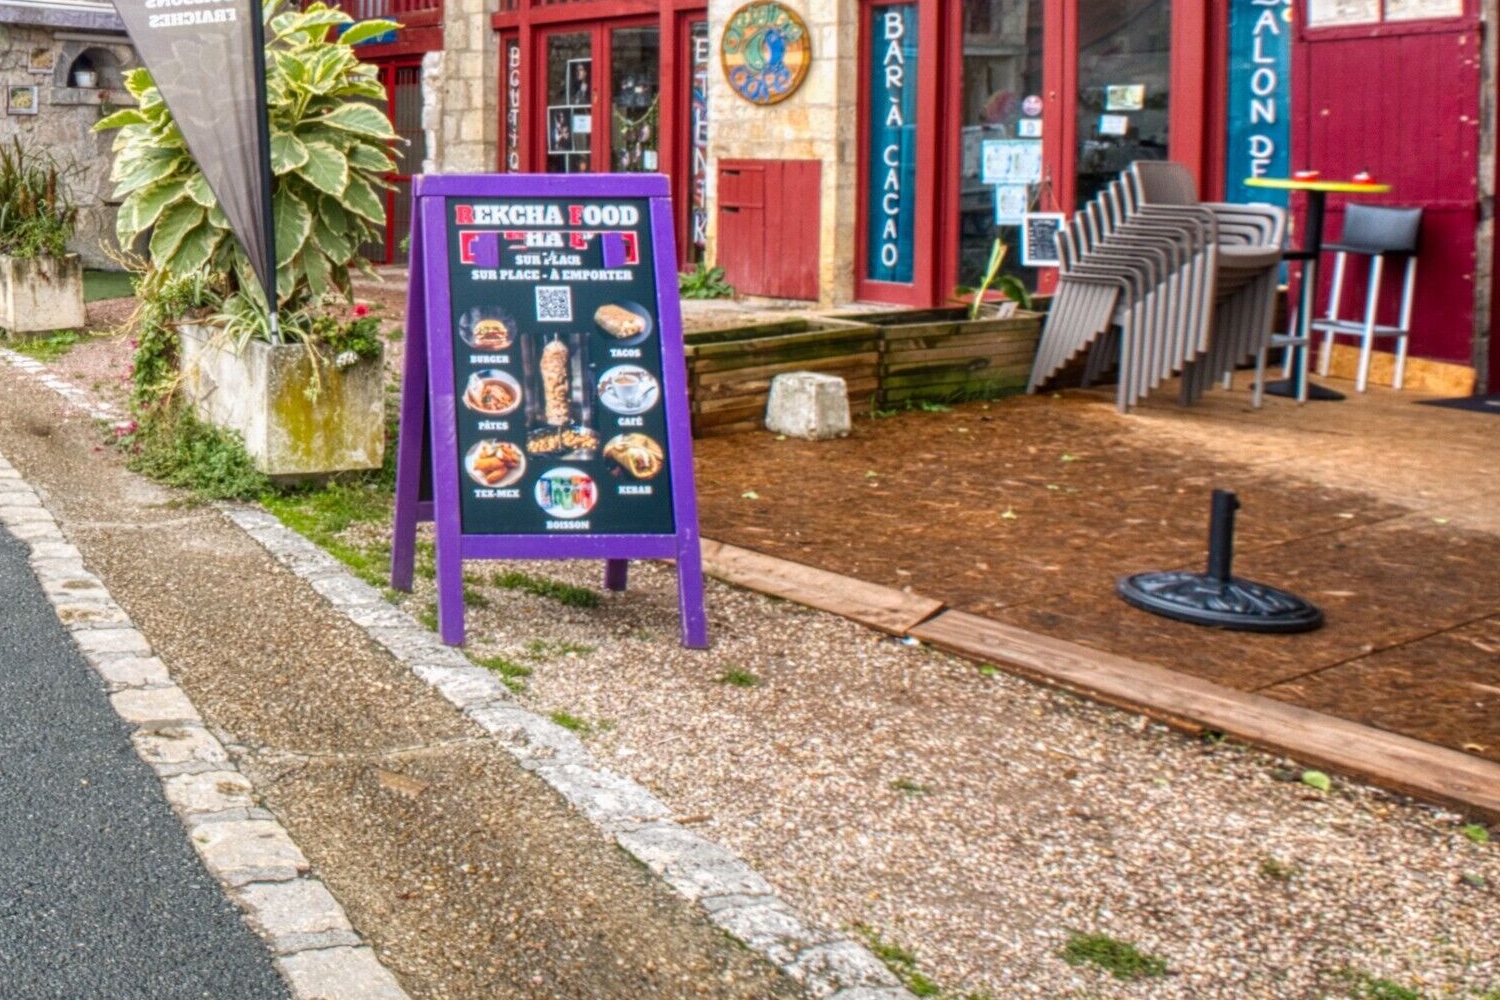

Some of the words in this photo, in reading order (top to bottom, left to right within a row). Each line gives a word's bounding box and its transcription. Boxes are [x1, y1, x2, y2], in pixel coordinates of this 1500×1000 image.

[884, 12, 904, 89] BAR
[885, 96, 903, 128] À
[882, 144, 900, 268] CACAO
[455, 204, 564, 226] REKCHA
[568, 204, 639, 226] FOOD
[471, 270, 497, 281] SUR
[500, 269, 541, 281] PLACE
[562, 270, 633, 281] EMPORTER
[470, 354, 510, 364] BURGER
[610, 348, 641, 358] TACOS
[478, 419, 509, 431] PÂTES
[618, 415, 643, 427] CAFÉ
[474, 488, 520, 499] TEX-MEX
[618, 485, 652, 496] KEBAB
[546, 520, 590, 531] BOISSON
